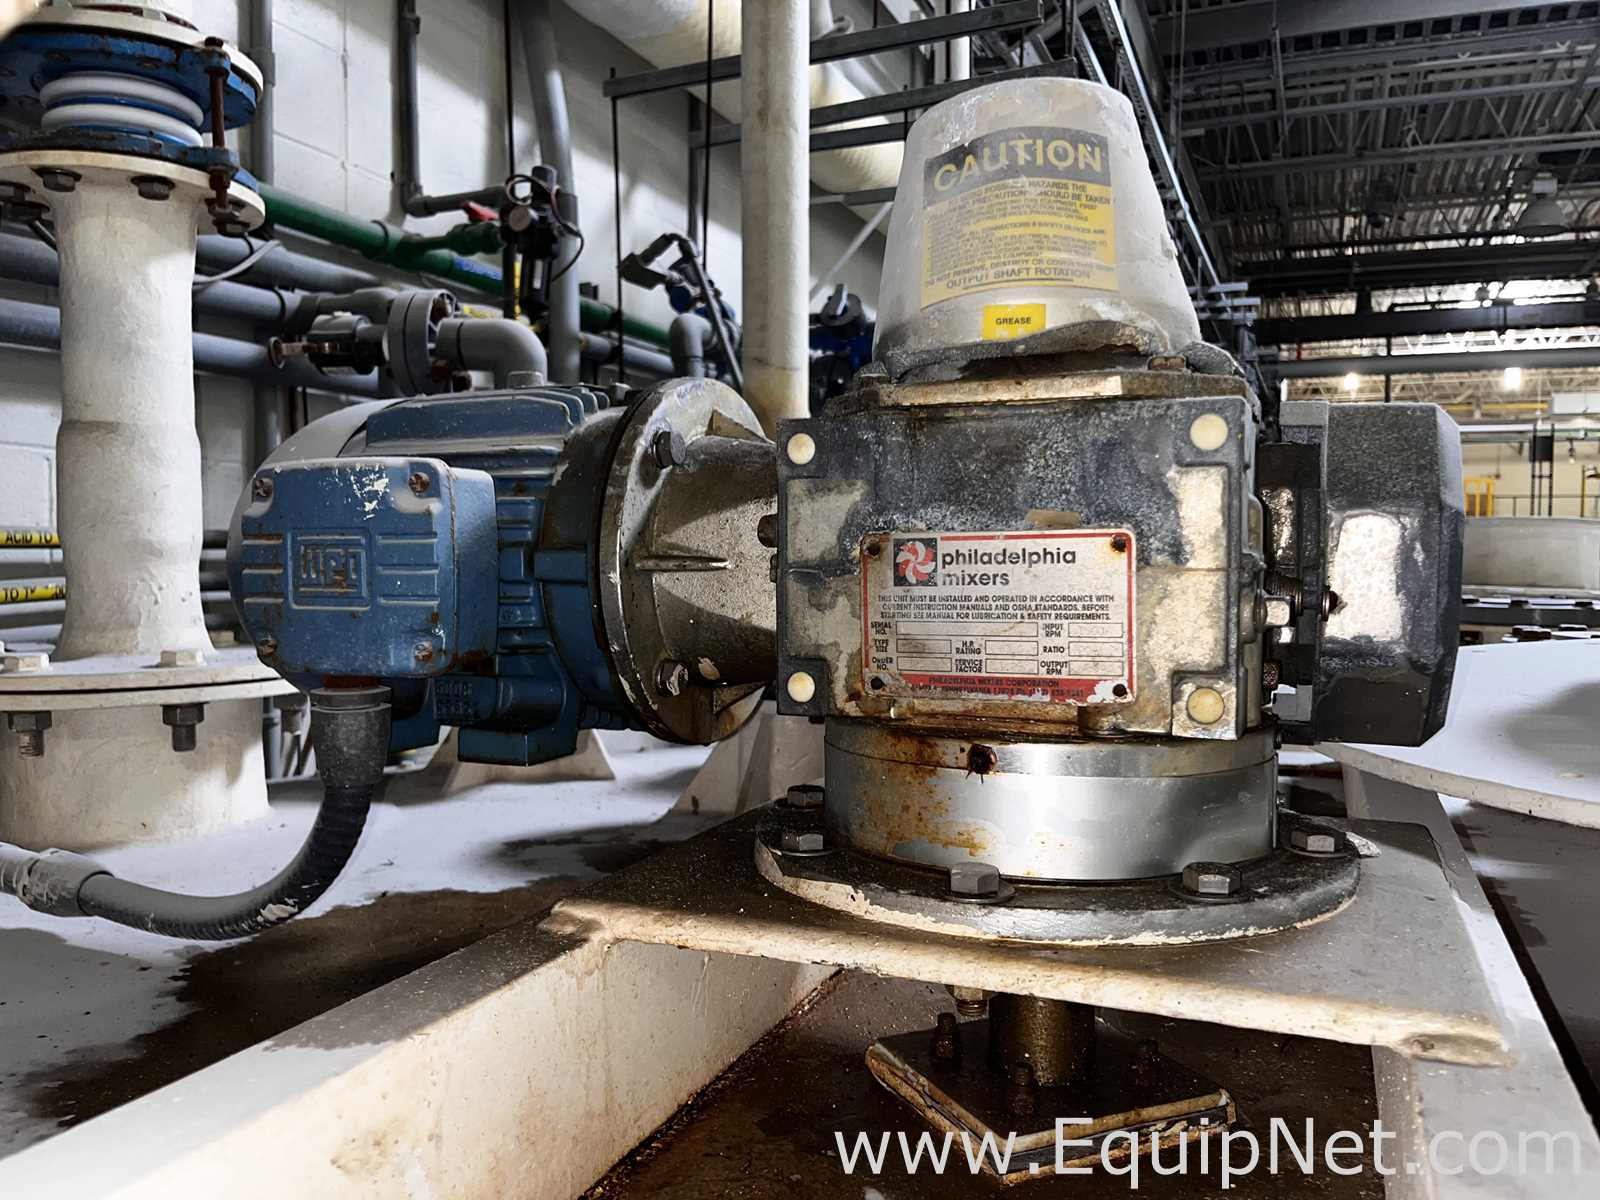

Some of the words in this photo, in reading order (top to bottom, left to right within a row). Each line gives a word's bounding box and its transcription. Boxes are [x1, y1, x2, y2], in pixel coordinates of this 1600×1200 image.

[934, 137, 1101, 192] CAUTION
[994, 267, 1031, 280] SHAFT
[1034, 266, 1090, 279] ROTATION
[995, 317, 1032, 325] GREASE
[941, 547, 1076, 570] philadelphia
[941, 570, 1010, 586] mixers
[956, 612, 970, 620] FOR
[1045, 630, 1061, 638] RPM
[1046, 668, 1062, 676] RPM
